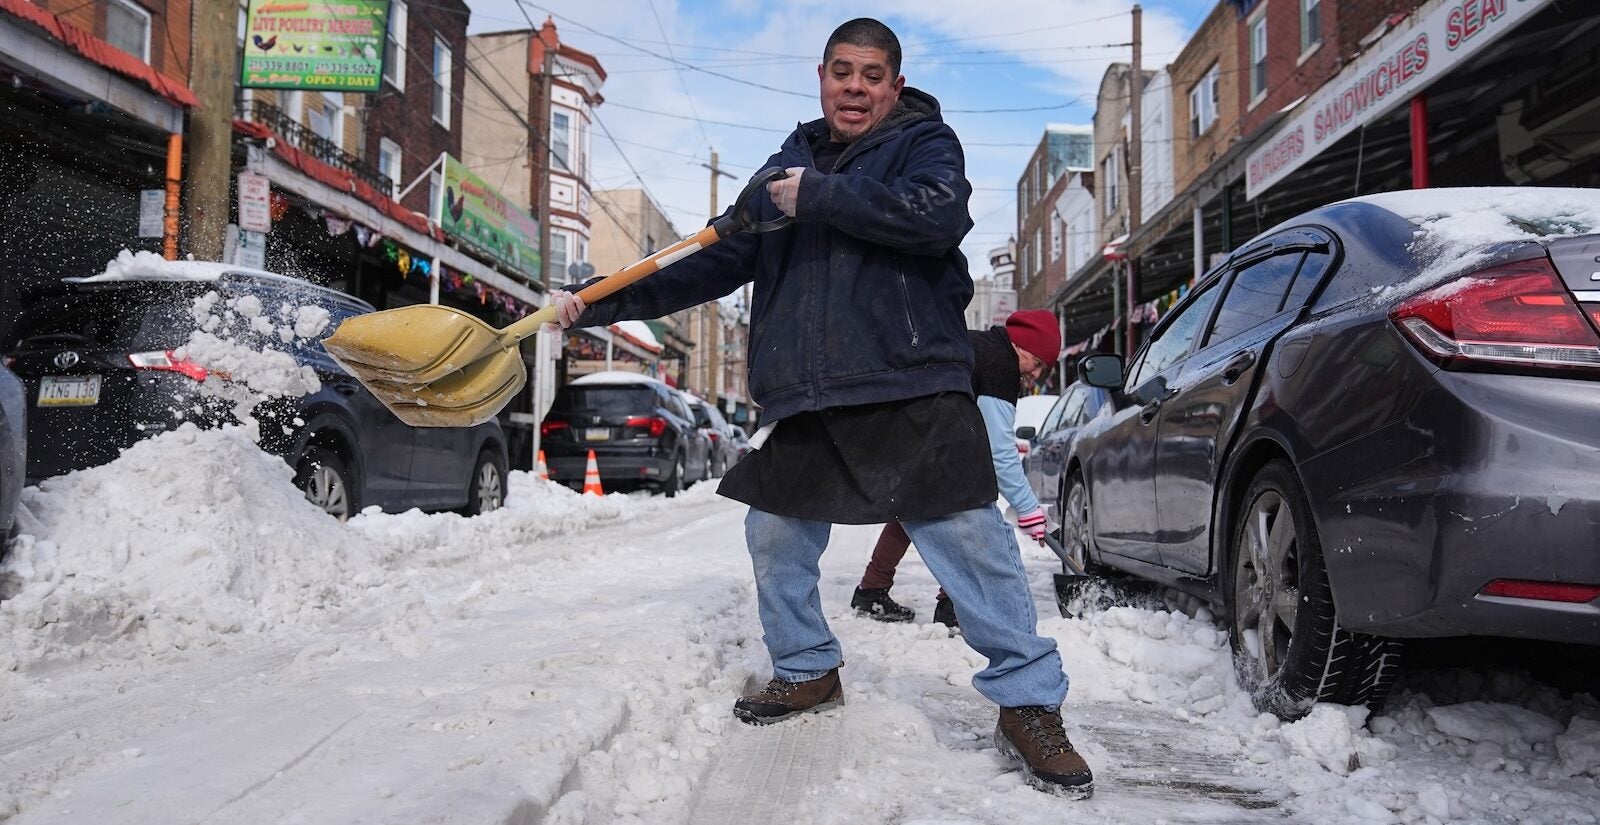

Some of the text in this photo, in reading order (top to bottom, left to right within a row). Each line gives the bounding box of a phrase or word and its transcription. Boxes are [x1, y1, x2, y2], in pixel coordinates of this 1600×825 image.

[253, 17, 373, 35] LIVE POULTRY MARKET
[304, 74, 336, 86] OPEN
[347, 75, 376, 88] DAYS
[1249, 126, 1305, 190] BURGERS
[1313, 32, 1429, 143] SANDWICHES
[43, 383, 71, 398] YING
